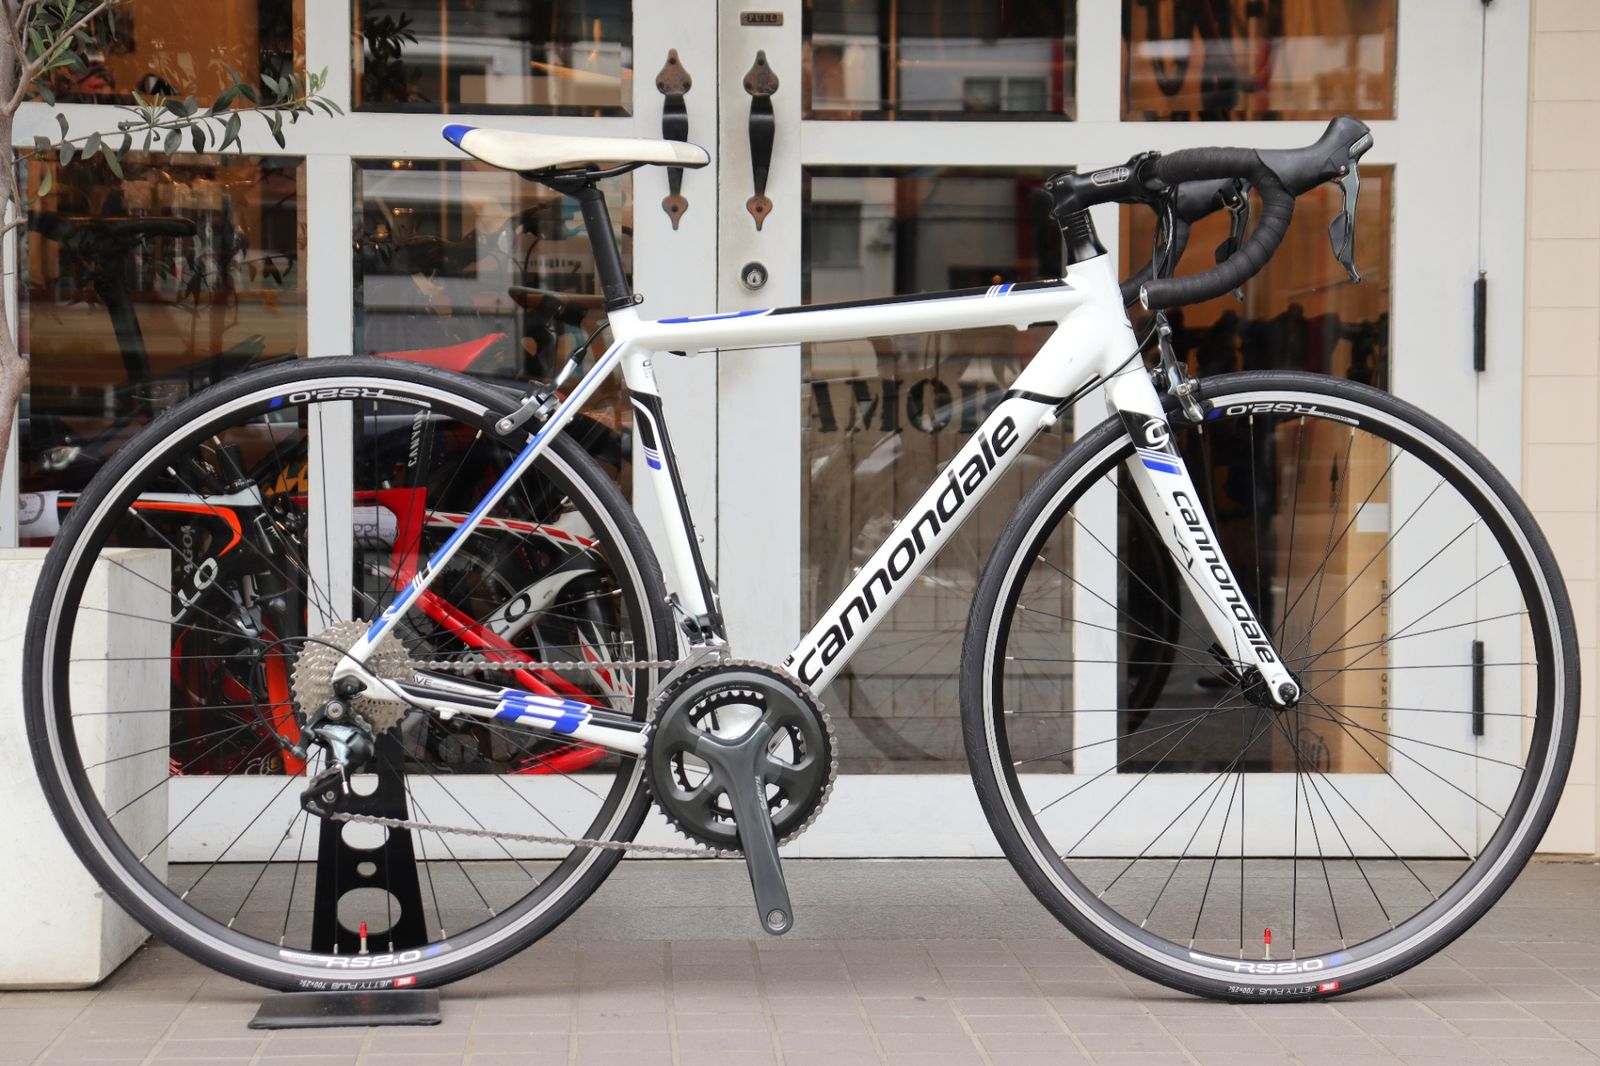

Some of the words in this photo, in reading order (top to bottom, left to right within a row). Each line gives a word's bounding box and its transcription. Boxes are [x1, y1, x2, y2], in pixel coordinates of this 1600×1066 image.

[289, 387, 386, 404] RS2.0
[1226, 402, 1318, 417] RS2.0
[797, 415, 1020, 687] cannondale
[1172, 490, 1276, 664] cannondale
[325, 950, 421, 969] RS2.0
[1233, 958, 1324, 974] RS2.0
[330, 981, 358, 991] PLUS
[359, 979, 392, 989] JETTY
[1258, 986, 1284, 996] PLUS
[1285, 985, 1317, 995] JETTY
